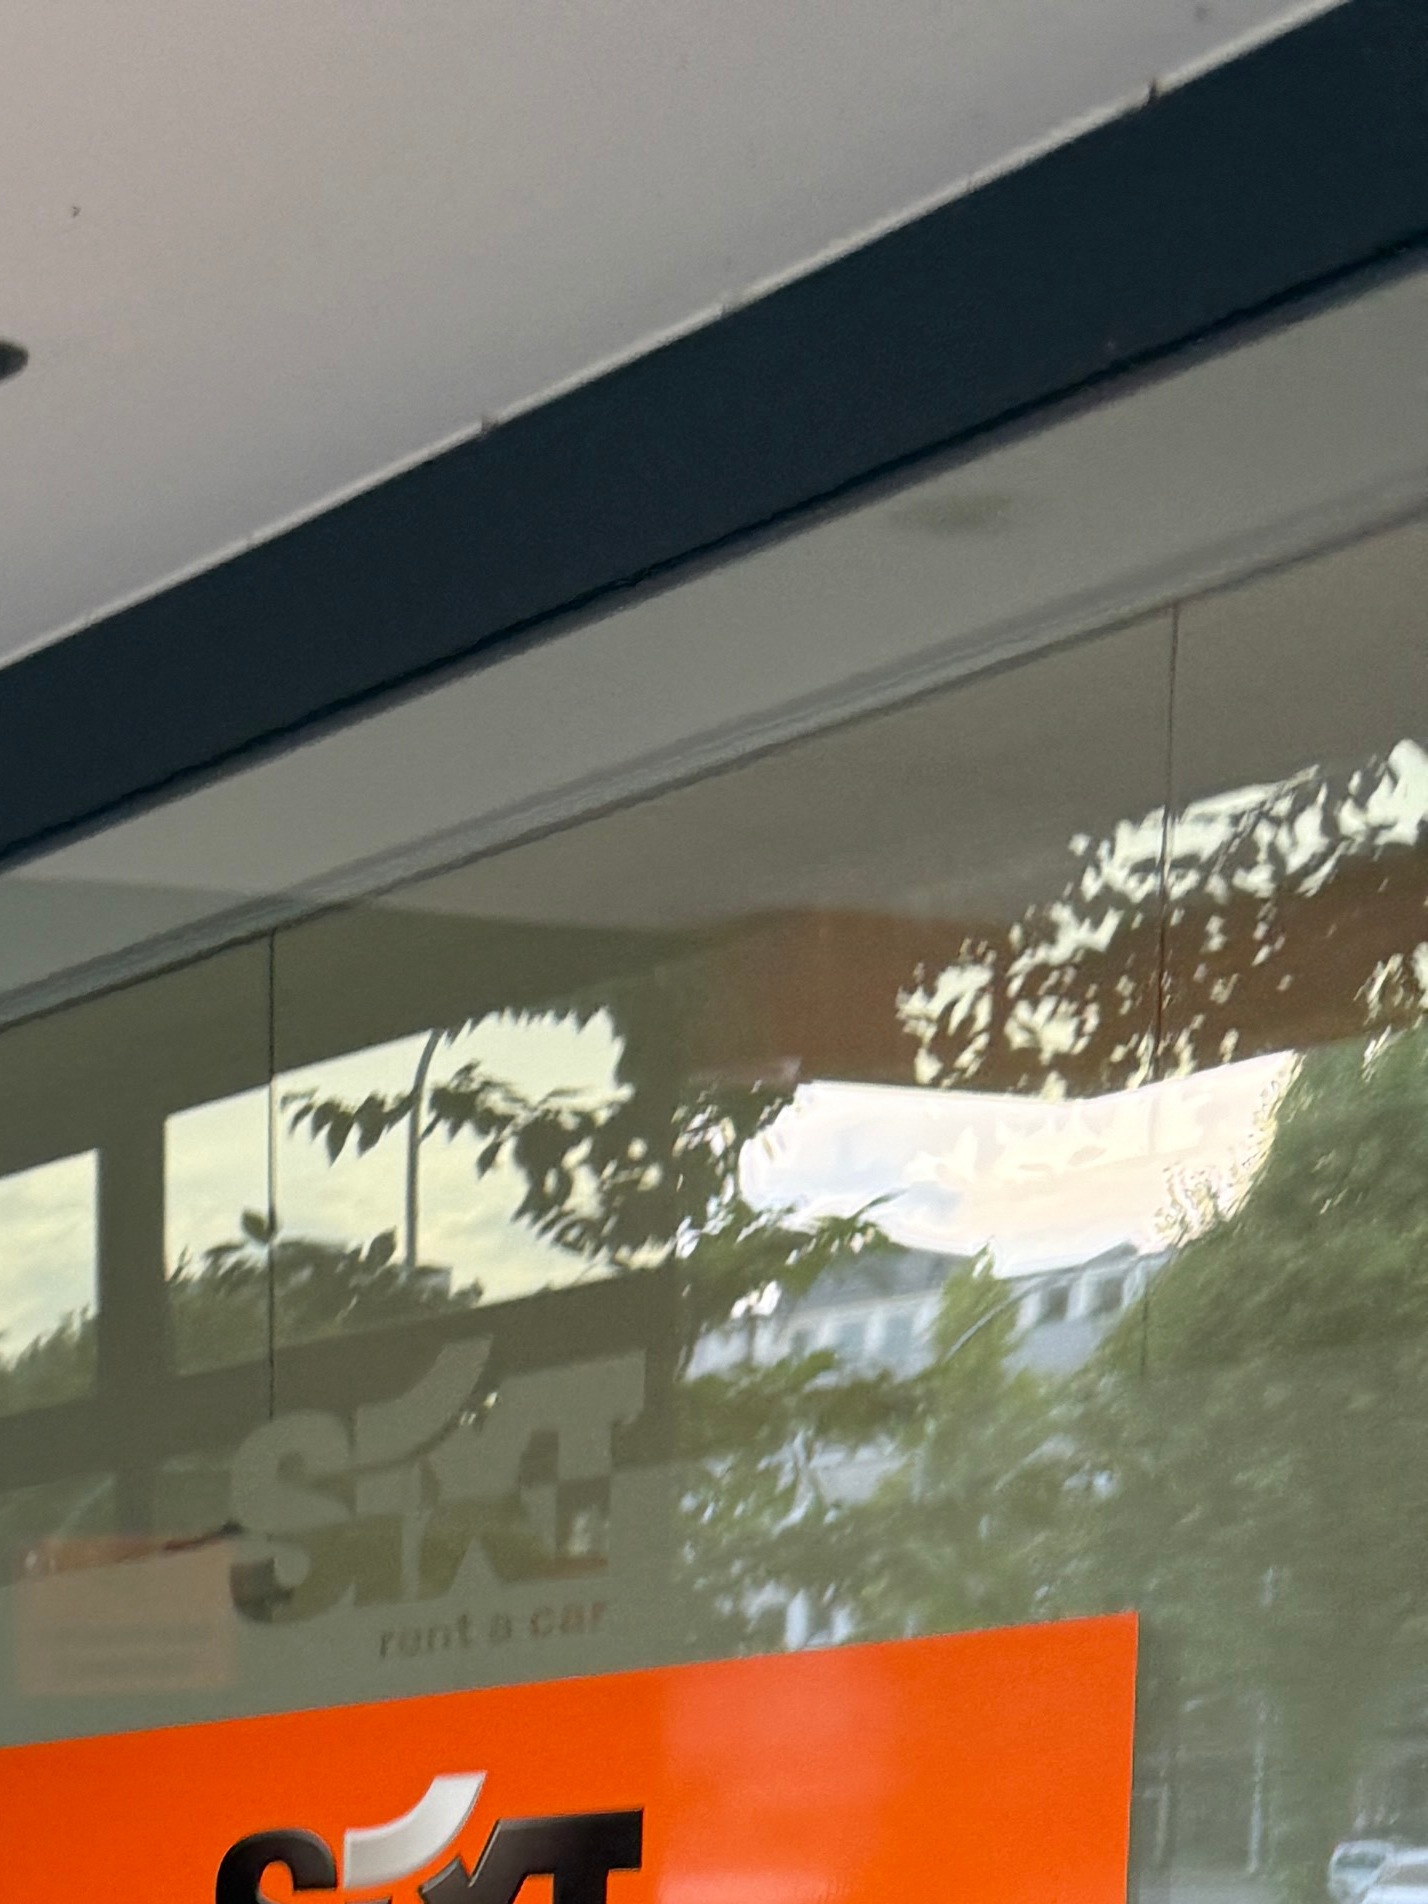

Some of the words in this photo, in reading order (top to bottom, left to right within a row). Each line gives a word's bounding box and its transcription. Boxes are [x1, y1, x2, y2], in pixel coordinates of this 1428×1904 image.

[376, 1611, 478, 1659] rent
[489, 1611, 513, 1642] a
[530, 1601, 608, 1639] car
